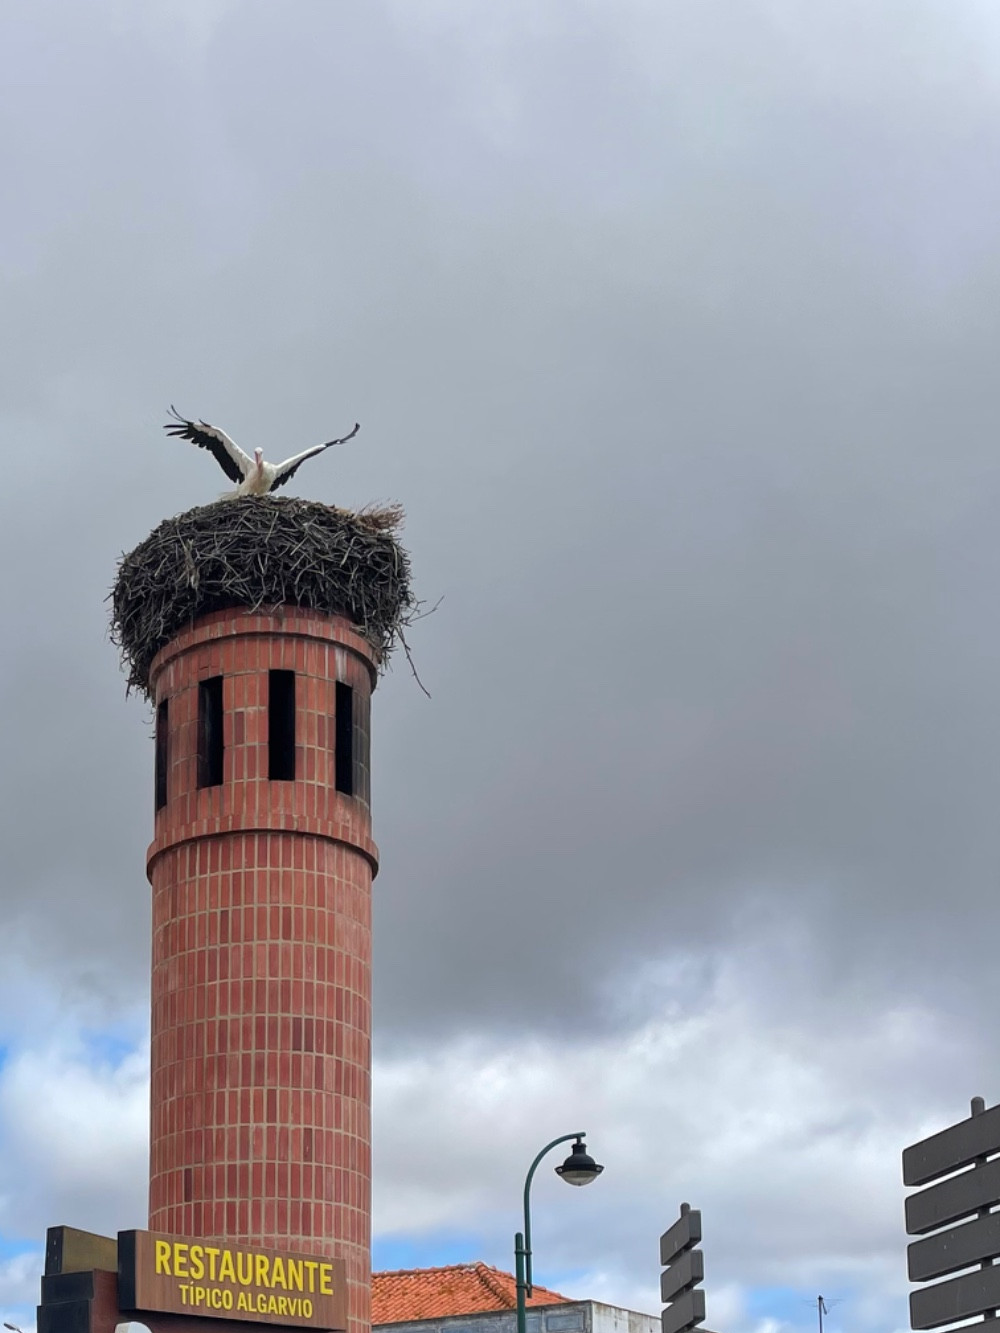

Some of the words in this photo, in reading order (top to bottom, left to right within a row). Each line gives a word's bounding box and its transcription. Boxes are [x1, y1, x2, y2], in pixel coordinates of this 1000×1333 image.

[155, 1240, 334, 1295] RESTAURANTE
[179, 1281, 233, 1310] TÍPICO
[237, 1292, 313, 1318] ALGARVIO
